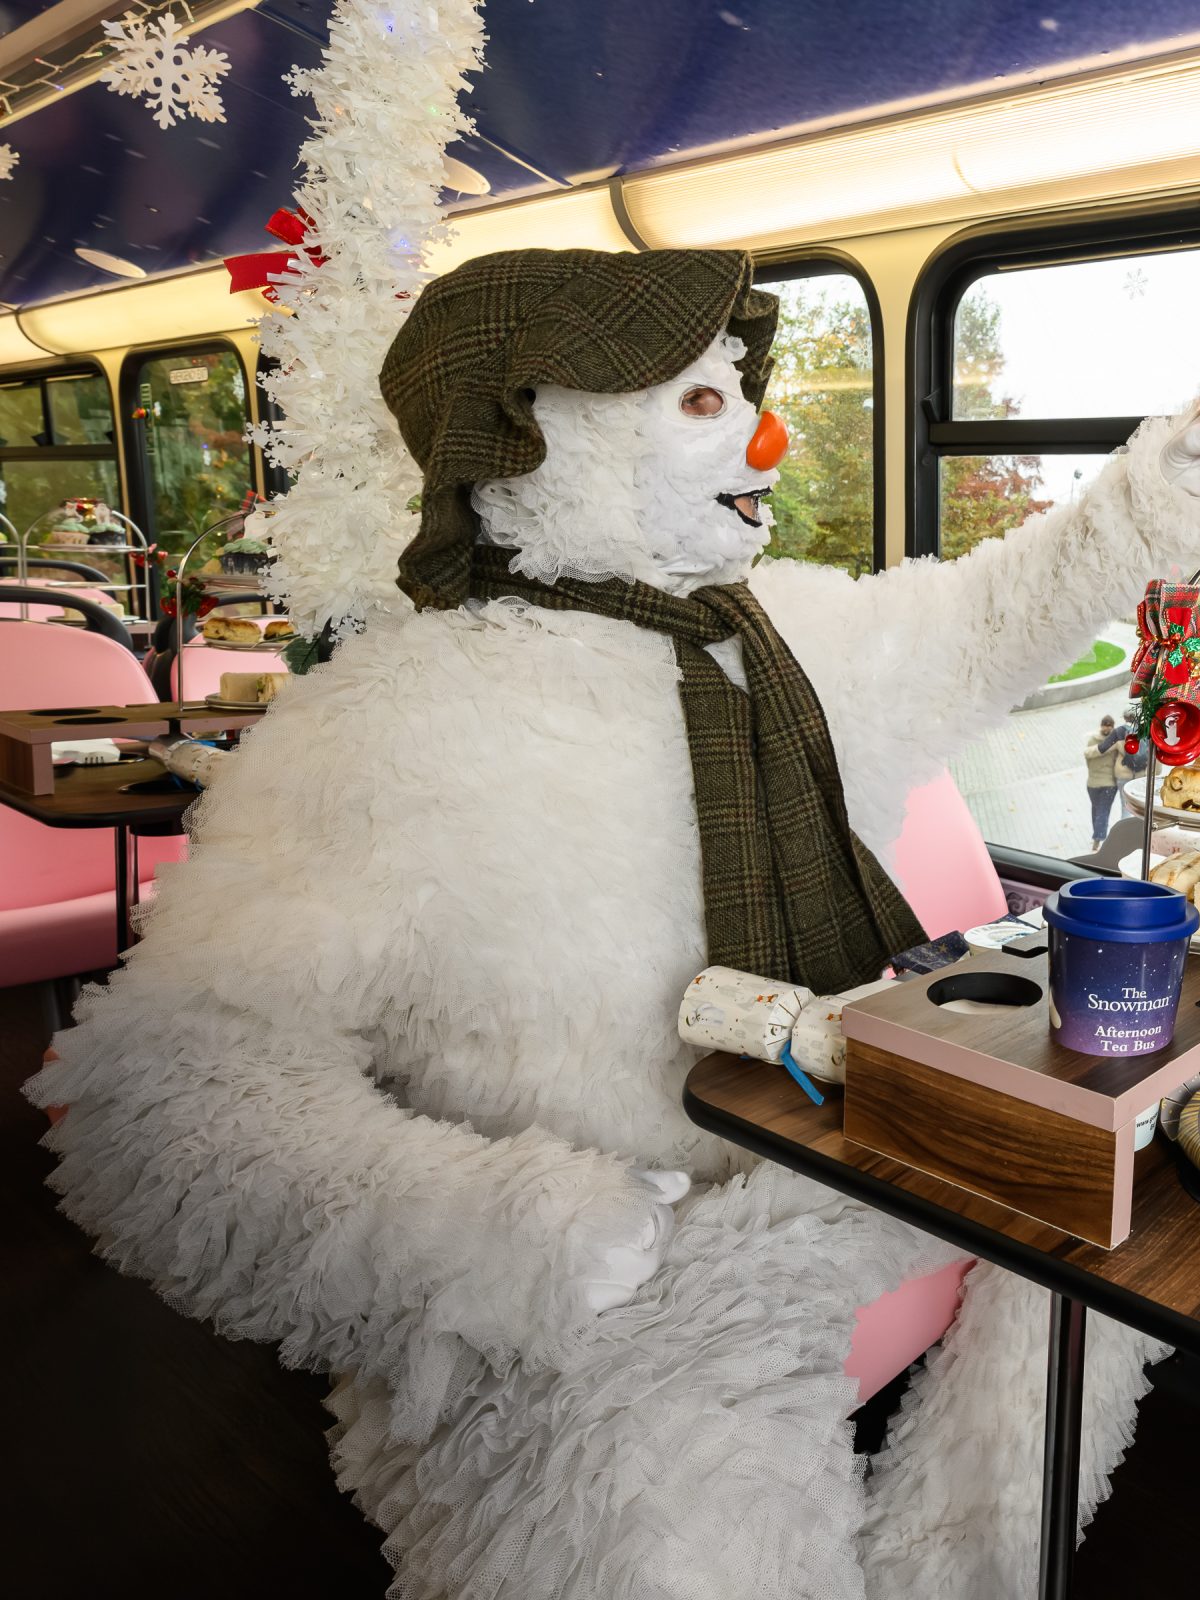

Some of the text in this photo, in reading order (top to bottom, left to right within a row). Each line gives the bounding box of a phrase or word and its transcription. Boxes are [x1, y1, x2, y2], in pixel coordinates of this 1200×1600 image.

[1121, 987, 1147, 998] The
[1088, 993, 1170, 1012] Snowman
[1094, 1025, 1162, 1038] Afternoon
[1100, 1040, 1156, 1052] Tea Bus
